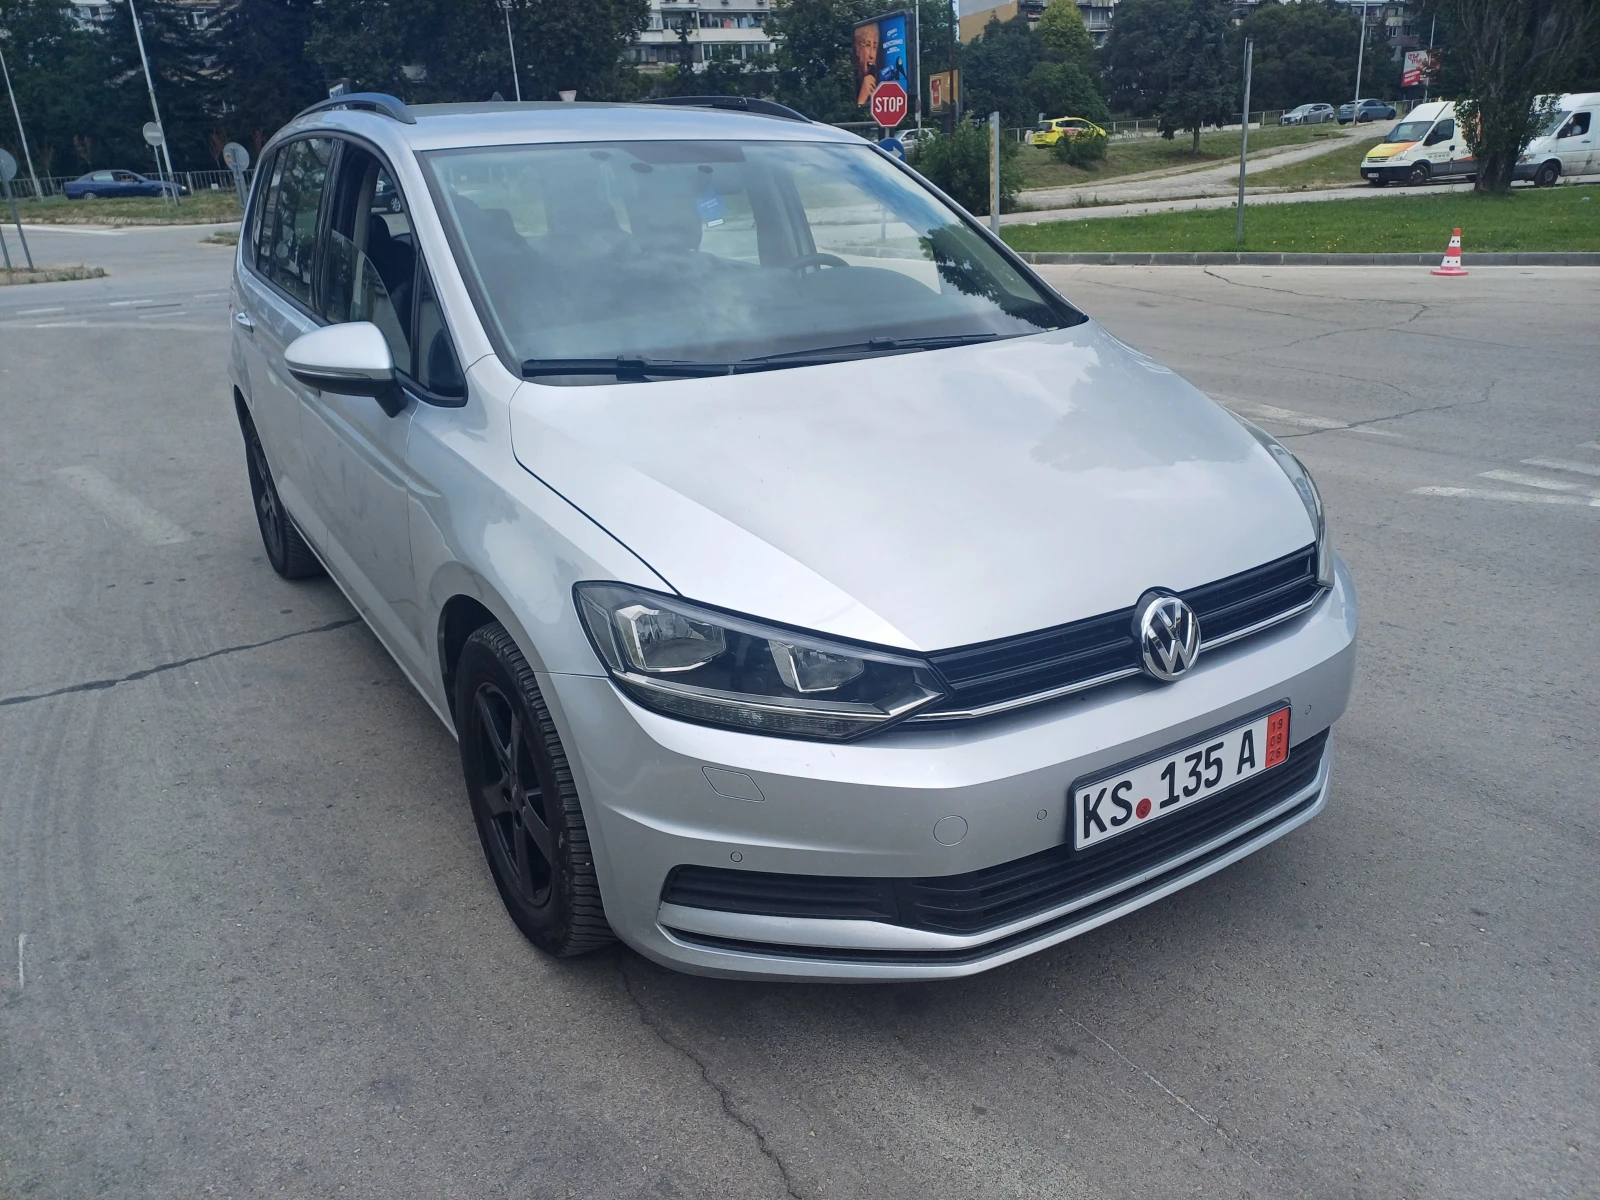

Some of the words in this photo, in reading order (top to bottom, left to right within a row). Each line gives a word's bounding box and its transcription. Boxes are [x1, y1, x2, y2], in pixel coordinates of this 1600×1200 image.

[875, 96, 904, 113] STOP
[1271, 717, 1284, 732] 19
[1270, 732, 1283, 747] 08
[1083, 779, 1133, 839] KS
[1159, 741, 1225, 809] 135
[1236, 728, 1256, 776] A
